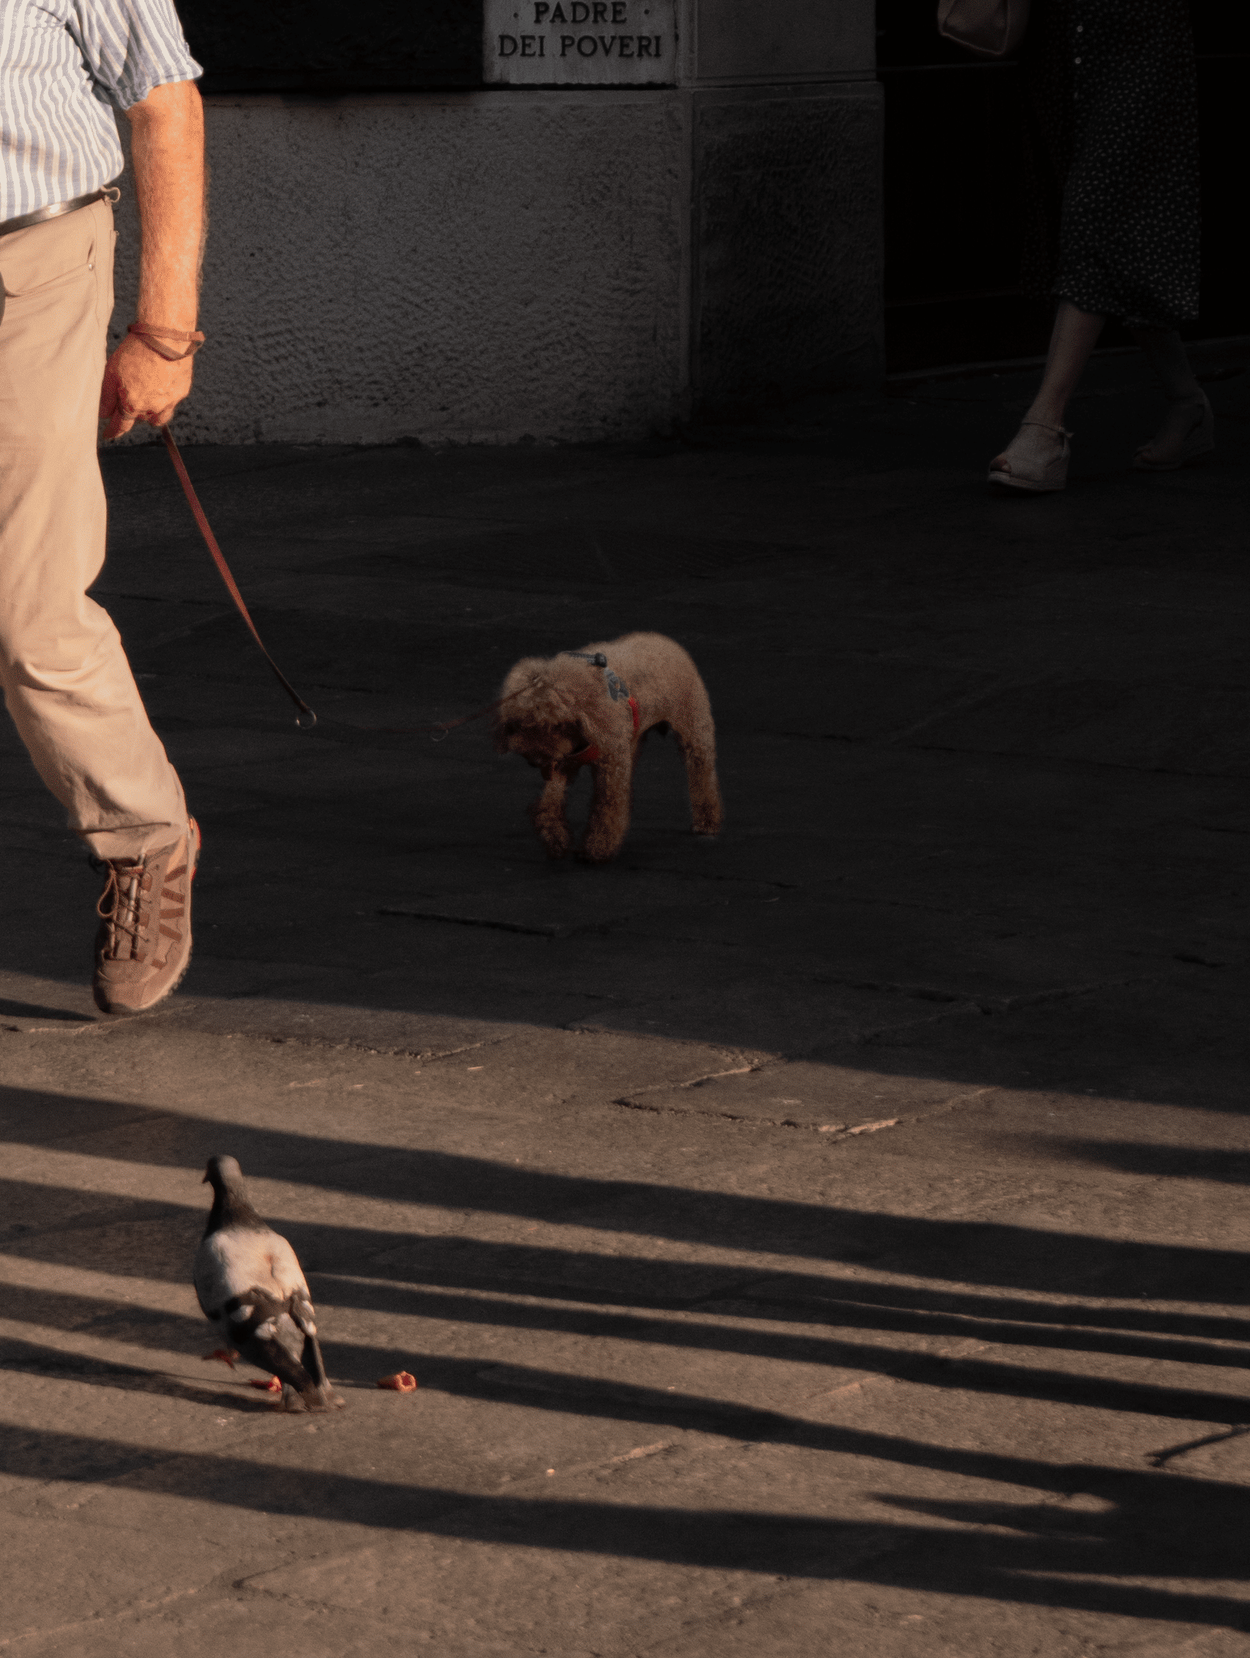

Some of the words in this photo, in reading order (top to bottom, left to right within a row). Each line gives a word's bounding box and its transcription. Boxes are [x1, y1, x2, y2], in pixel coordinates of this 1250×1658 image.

[533, 1, 628, 24] PADRE
[498, 35, 546, 58] DEI
[559, 35, 662, 58] POVERI
